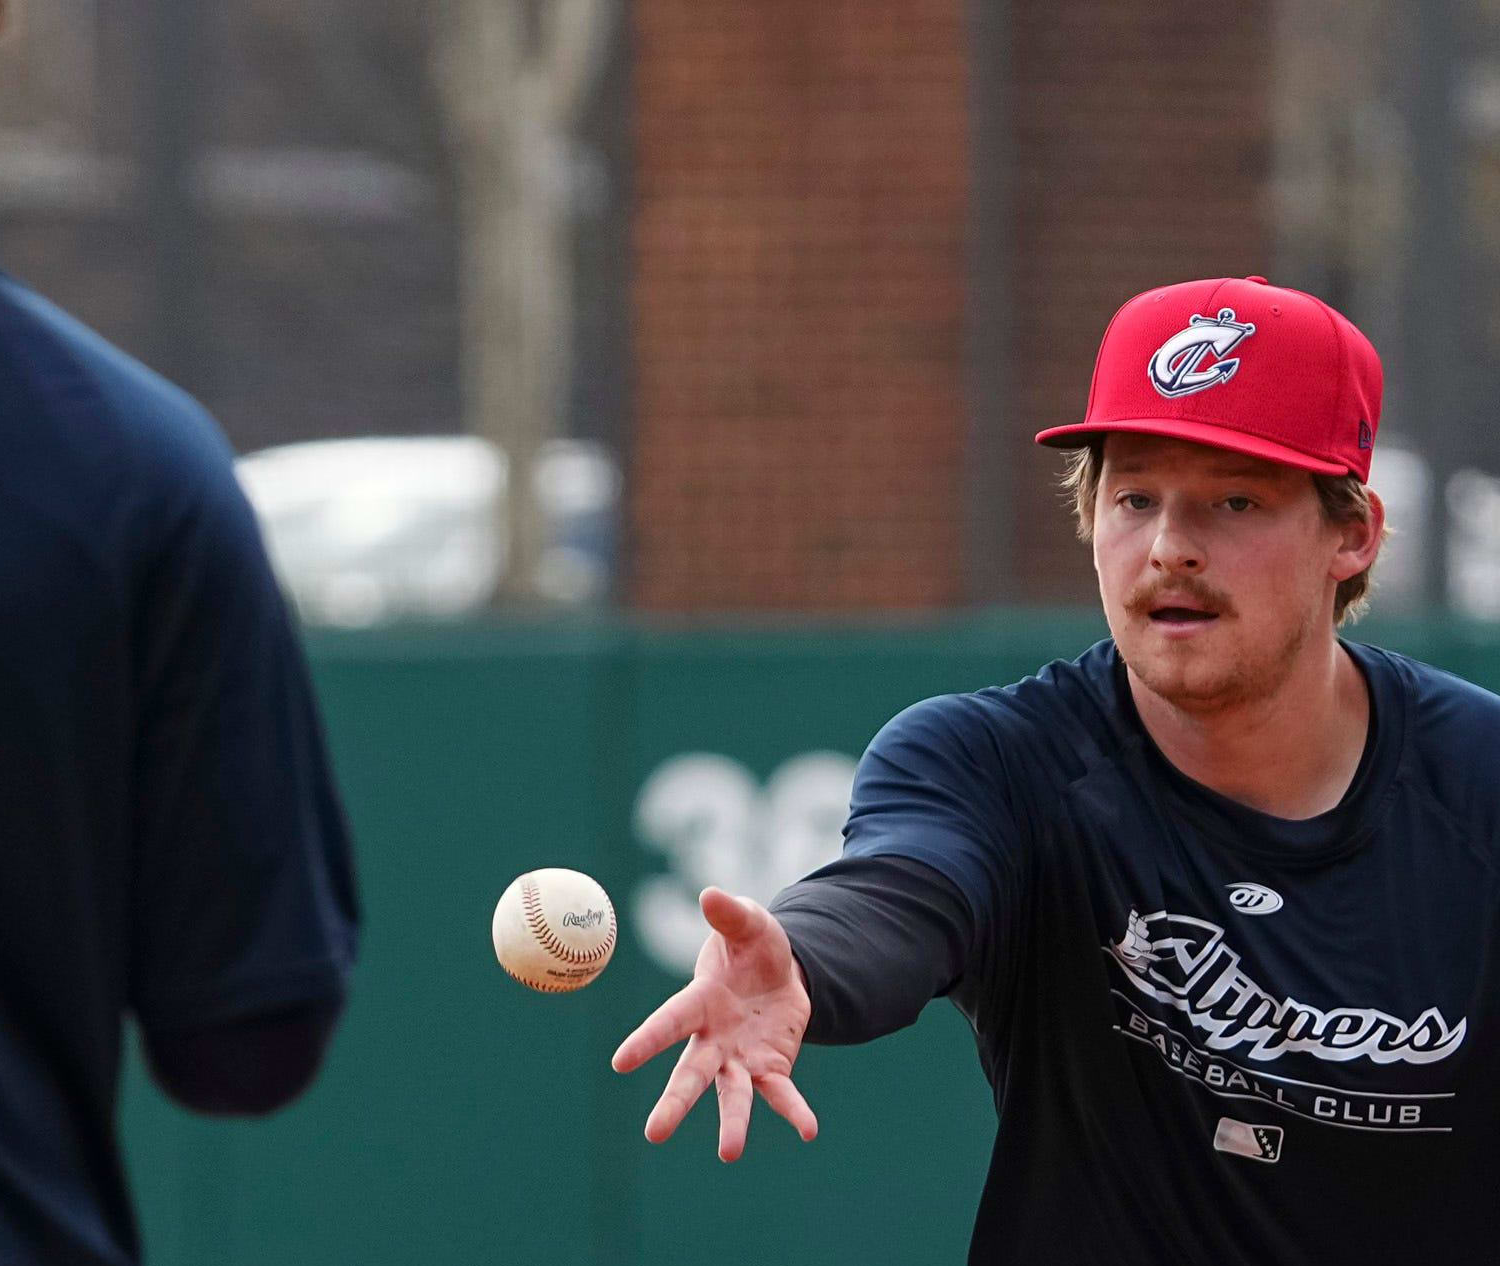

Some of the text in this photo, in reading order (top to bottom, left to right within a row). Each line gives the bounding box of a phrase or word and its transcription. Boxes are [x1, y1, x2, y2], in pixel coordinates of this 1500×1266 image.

[1101, 911, 1467, 1064] Clippers
[1128, 1012, 1421, 1124] BASEBALL CLUB
